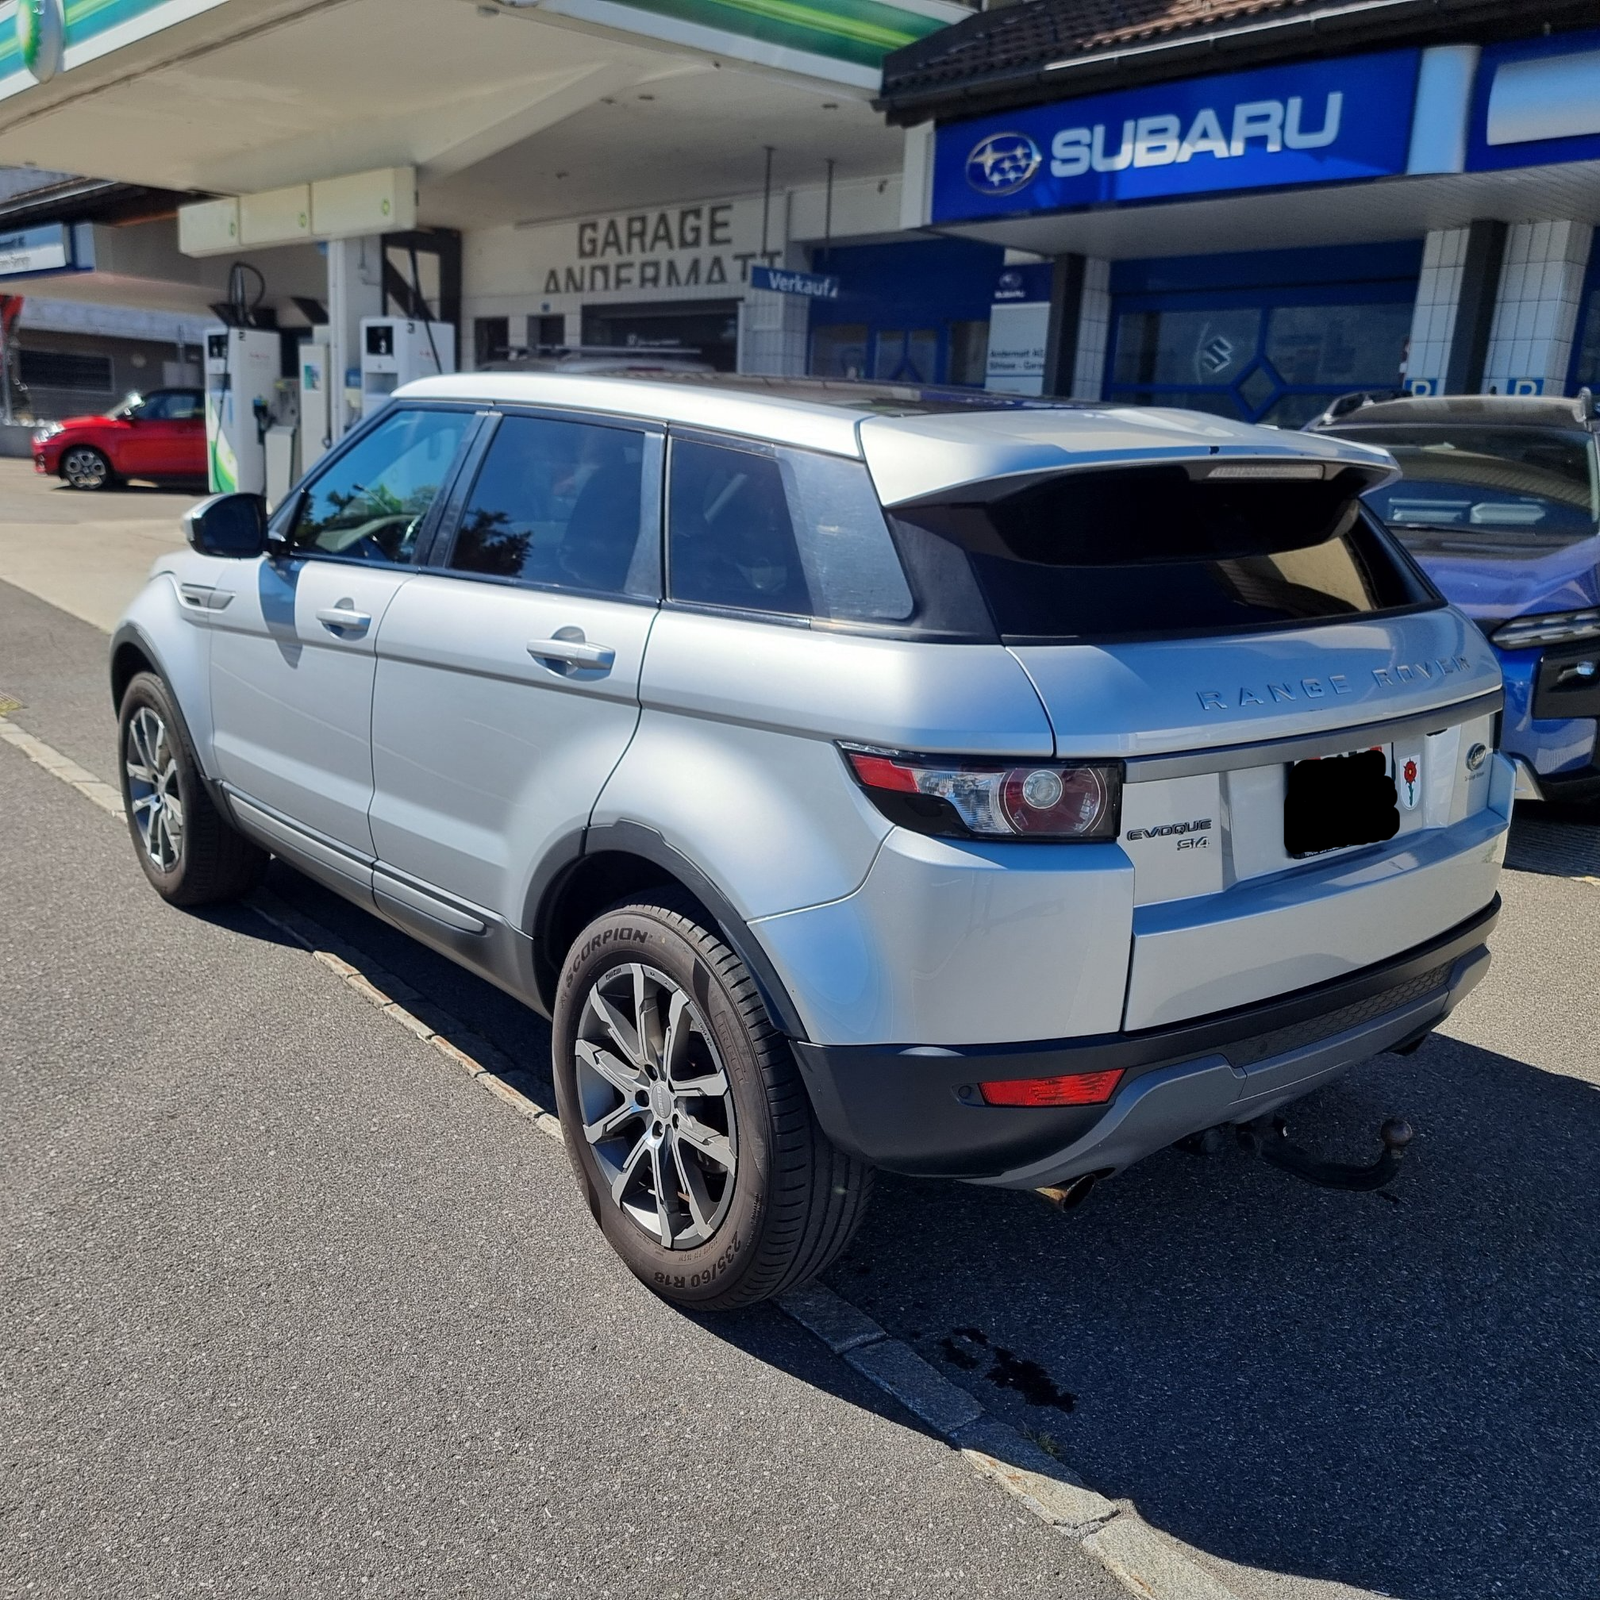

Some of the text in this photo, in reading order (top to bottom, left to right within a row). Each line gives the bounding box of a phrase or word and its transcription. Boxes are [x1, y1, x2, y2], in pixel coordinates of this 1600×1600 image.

[1051, 92, 1343, 178] SUBARU
[578, 204, 733, 260] GARAGE
[768, 270, 832, 298] Verkauf
[1196, 655, 1471, 710] RANGE ROVER
[1126, 818, 1212, 841] EVOQUE
[565, 927, 650, 989] SCORPION
[653, 1271, 686, 1289] R18
[690, 1230, 742, 1288] 235/60
